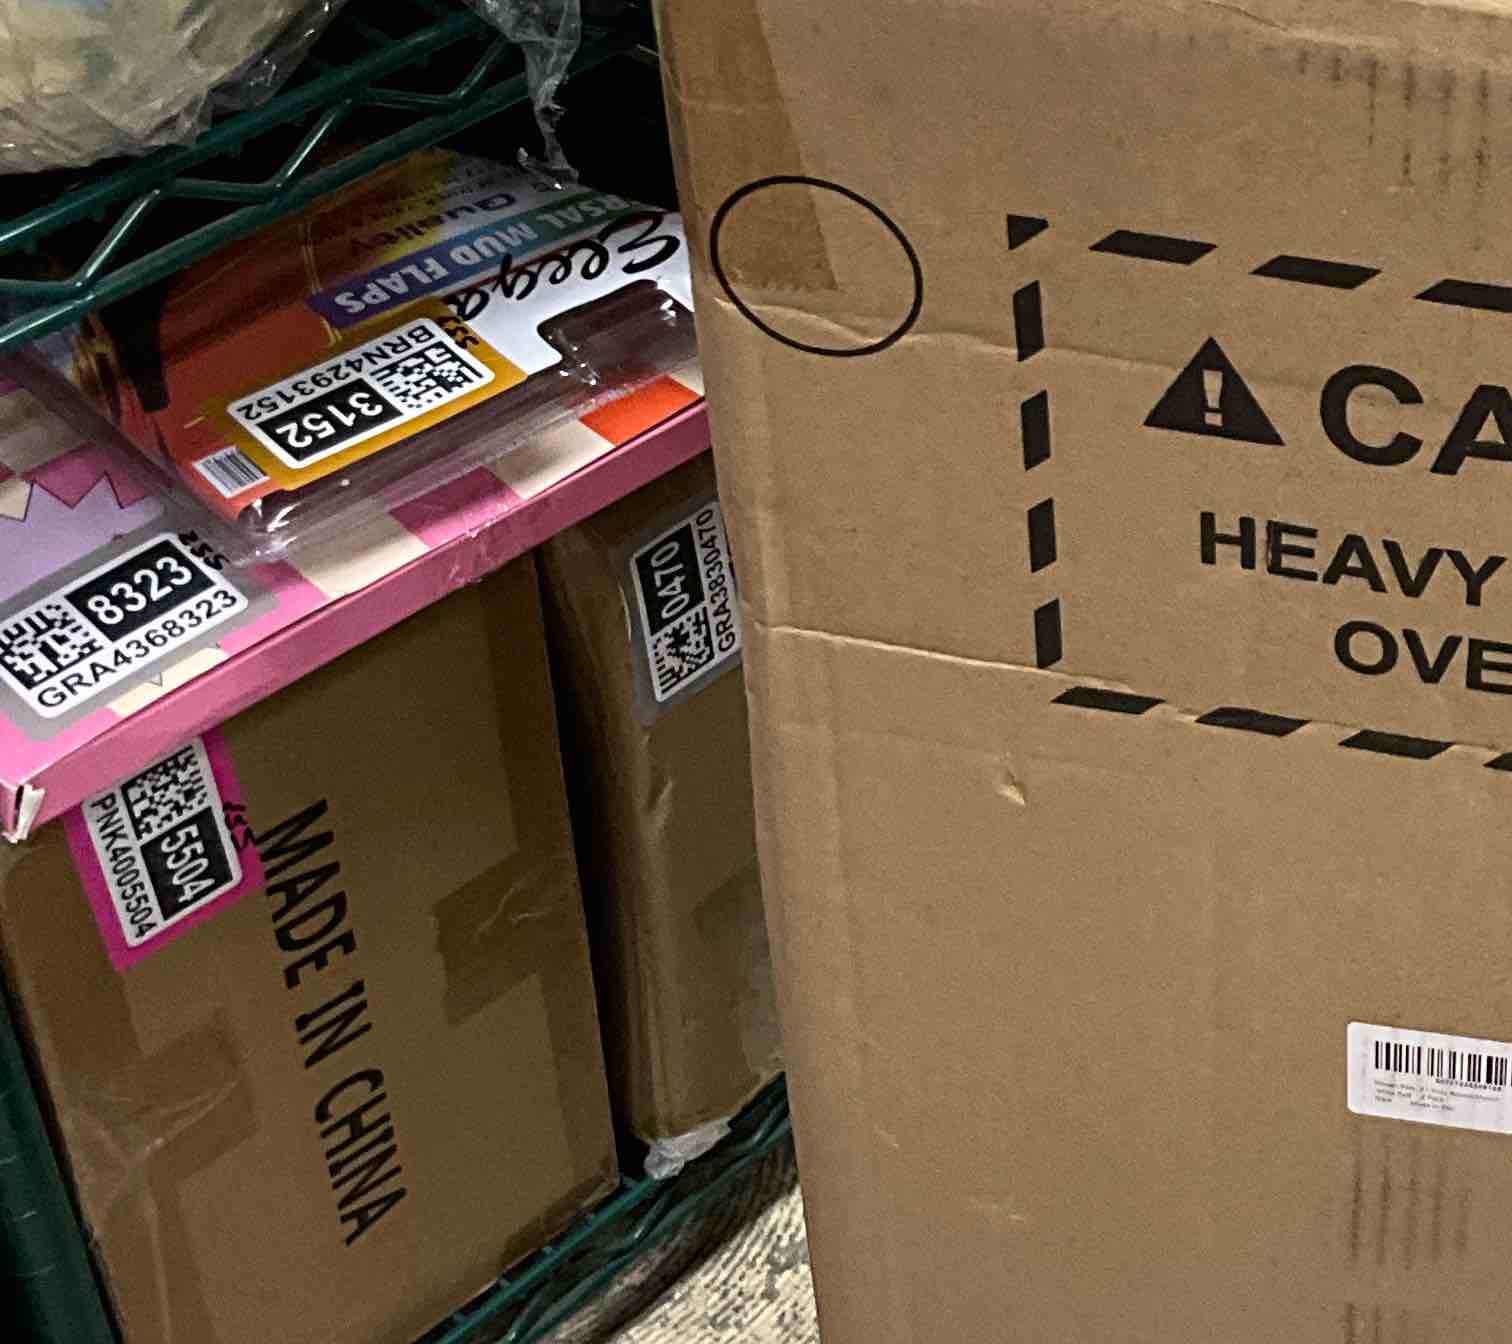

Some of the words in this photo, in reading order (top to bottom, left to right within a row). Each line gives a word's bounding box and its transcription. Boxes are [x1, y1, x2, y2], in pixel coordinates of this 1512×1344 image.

[333, 262, 450, 313] FLAPS
[450, 221, 539, 265] MUD
[236, 324, 435, 421] BRN4293152
[275, 392, 384, 448] 3152
[87, 556, 194, 625] 8323
[651, 540, 690, 621] 0470
[695, 508, 737, 653] GRA3830470
[1199, 510, 1507, 606] HEAVY
[37, 589, 238, 708] GRA4368323
[90, 791, 158, 940] PNK4005504
[160, 823, 217, 904] 5504
[255, 799, 357, 990] MADE
[294, 979, 373, 1070] IN
[313, 1066, 409, 1248] CHINA
